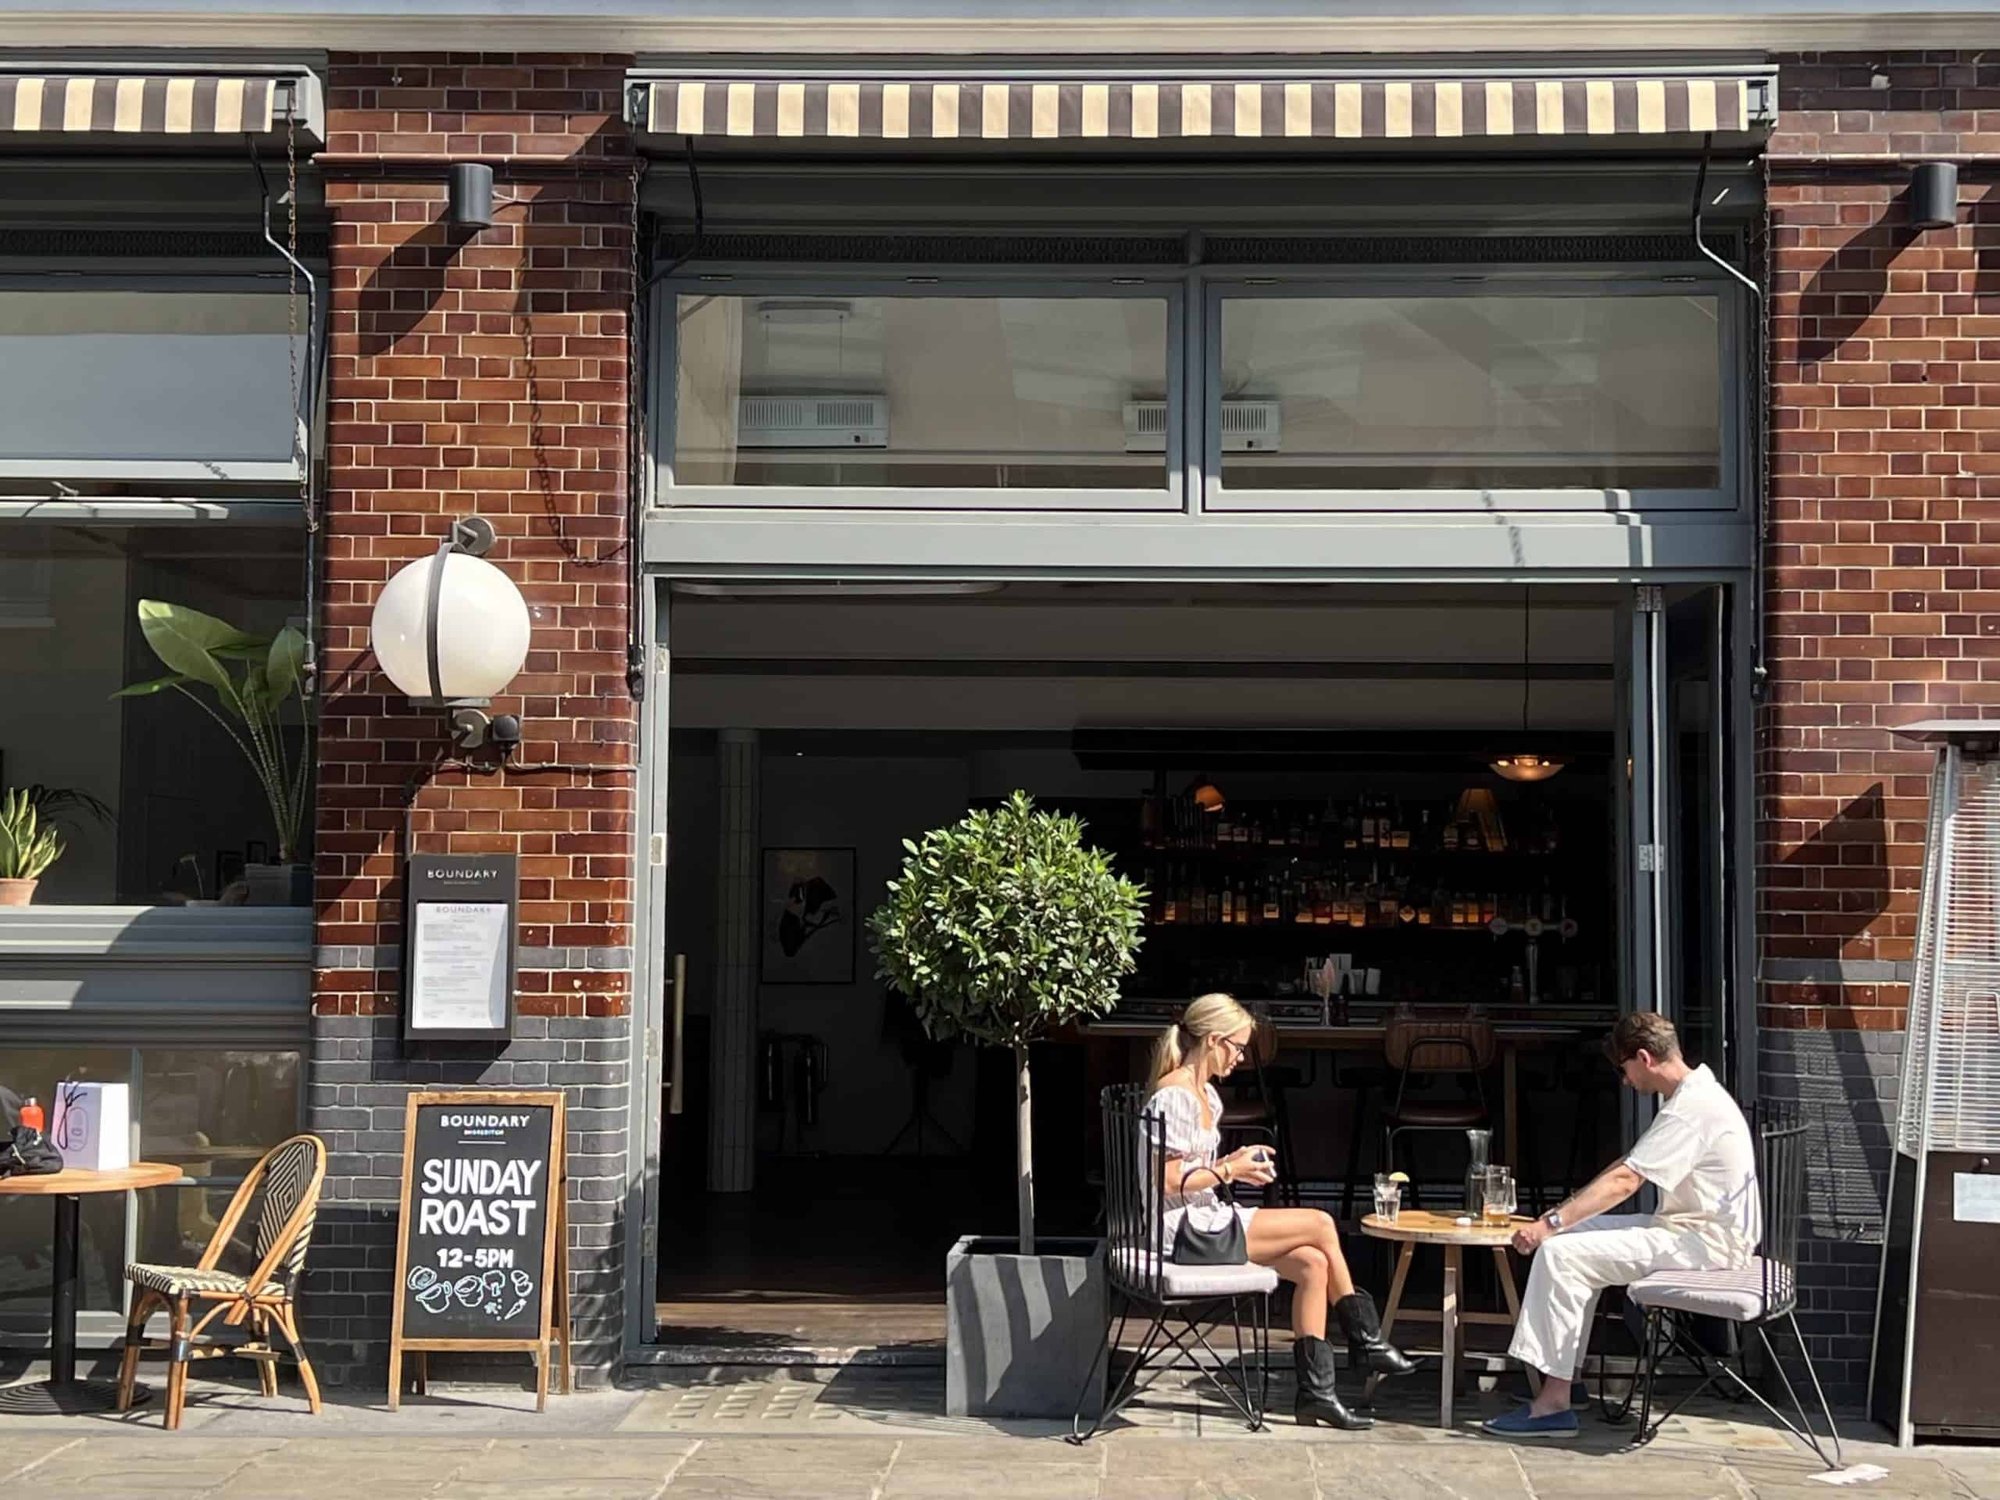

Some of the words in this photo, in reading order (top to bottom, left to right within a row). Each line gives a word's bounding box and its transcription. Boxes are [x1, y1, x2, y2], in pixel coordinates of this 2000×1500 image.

[427, 870, 498, 879] BOUNDARY
[440, 1115, 530, 1127] BOUNDARY
[421, 1158, 542, 1196] SUNDAY
[419, 1198, 537, 1236] ROAST
[436, 1248, 514, 1269] 12-5PM
